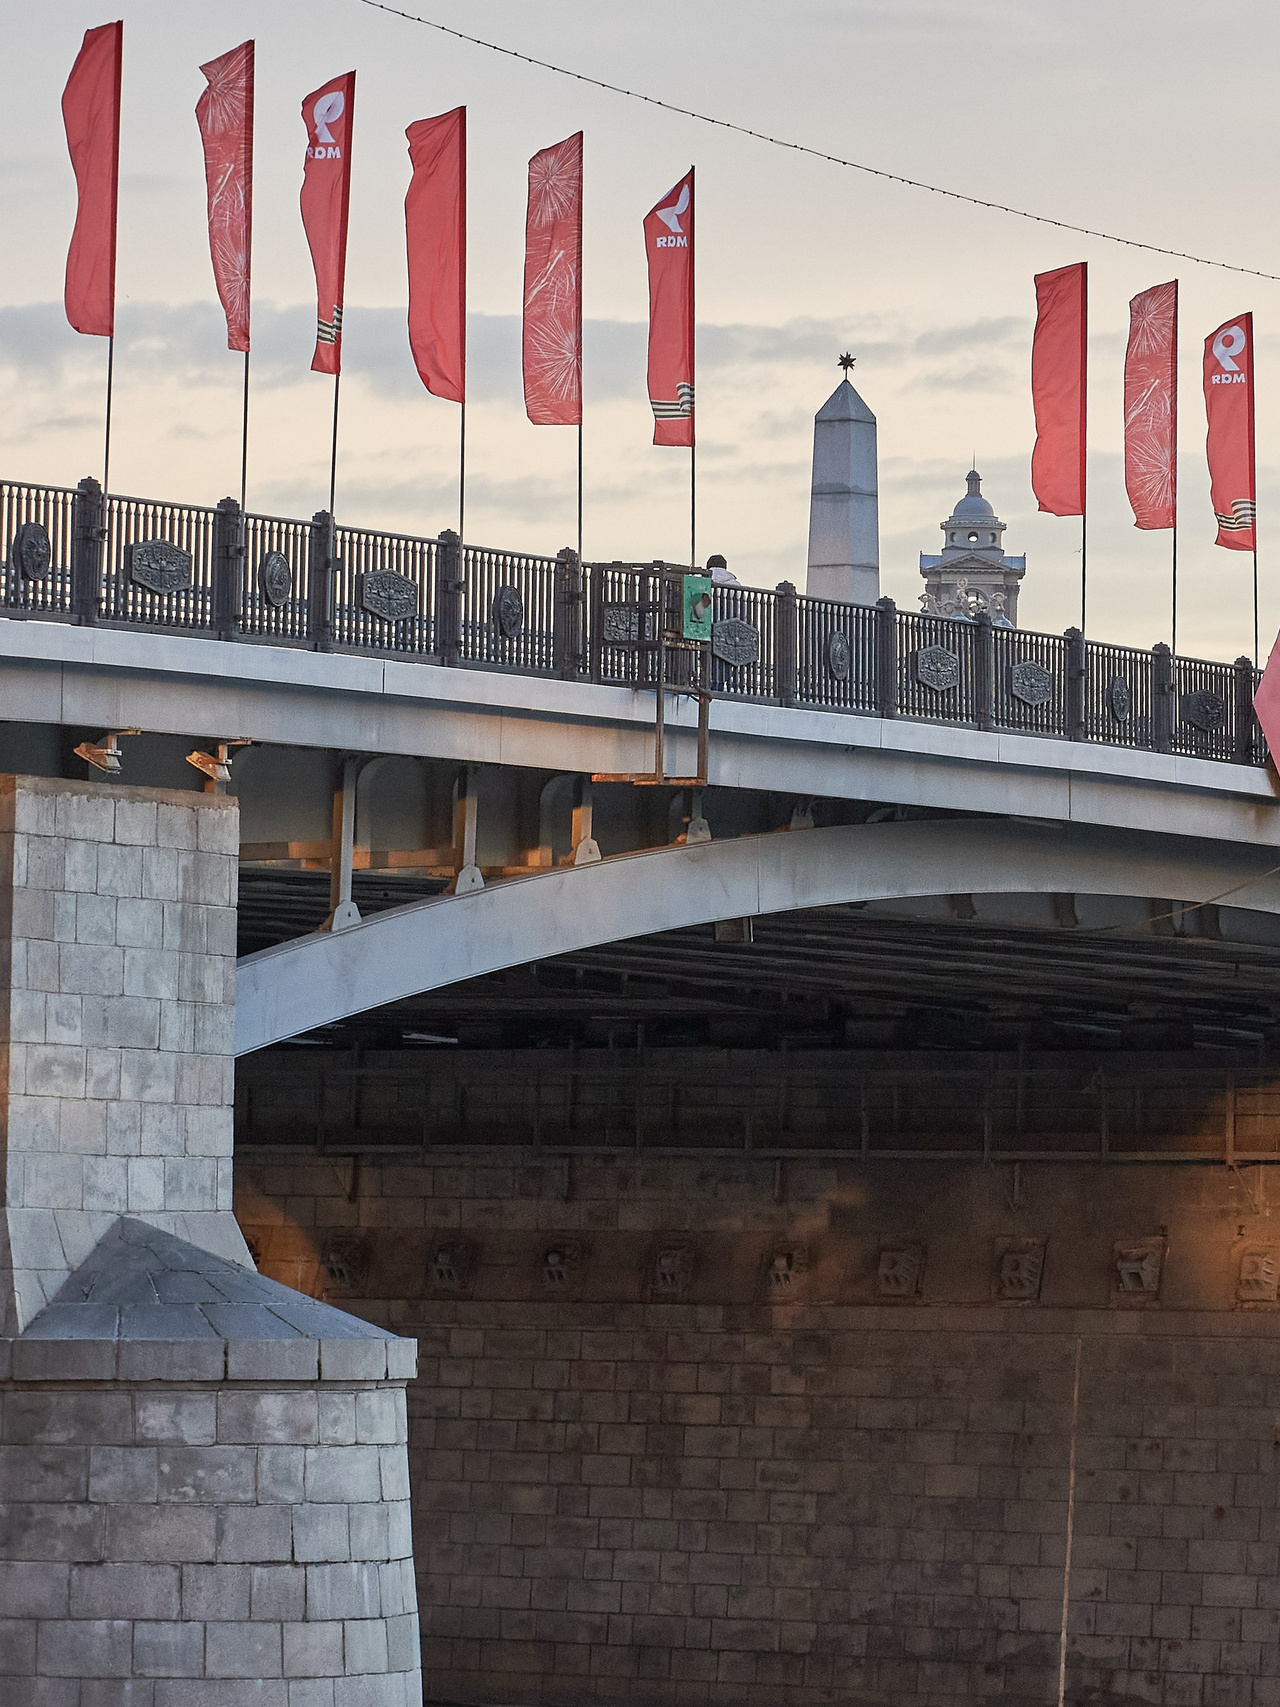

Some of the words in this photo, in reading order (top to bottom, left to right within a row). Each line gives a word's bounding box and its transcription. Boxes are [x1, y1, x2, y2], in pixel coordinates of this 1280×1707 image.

[307, 146, 342, 160] RDM
[656, 235, 689, 249] RDM
[1211, 373, 1246, 385] RDM
